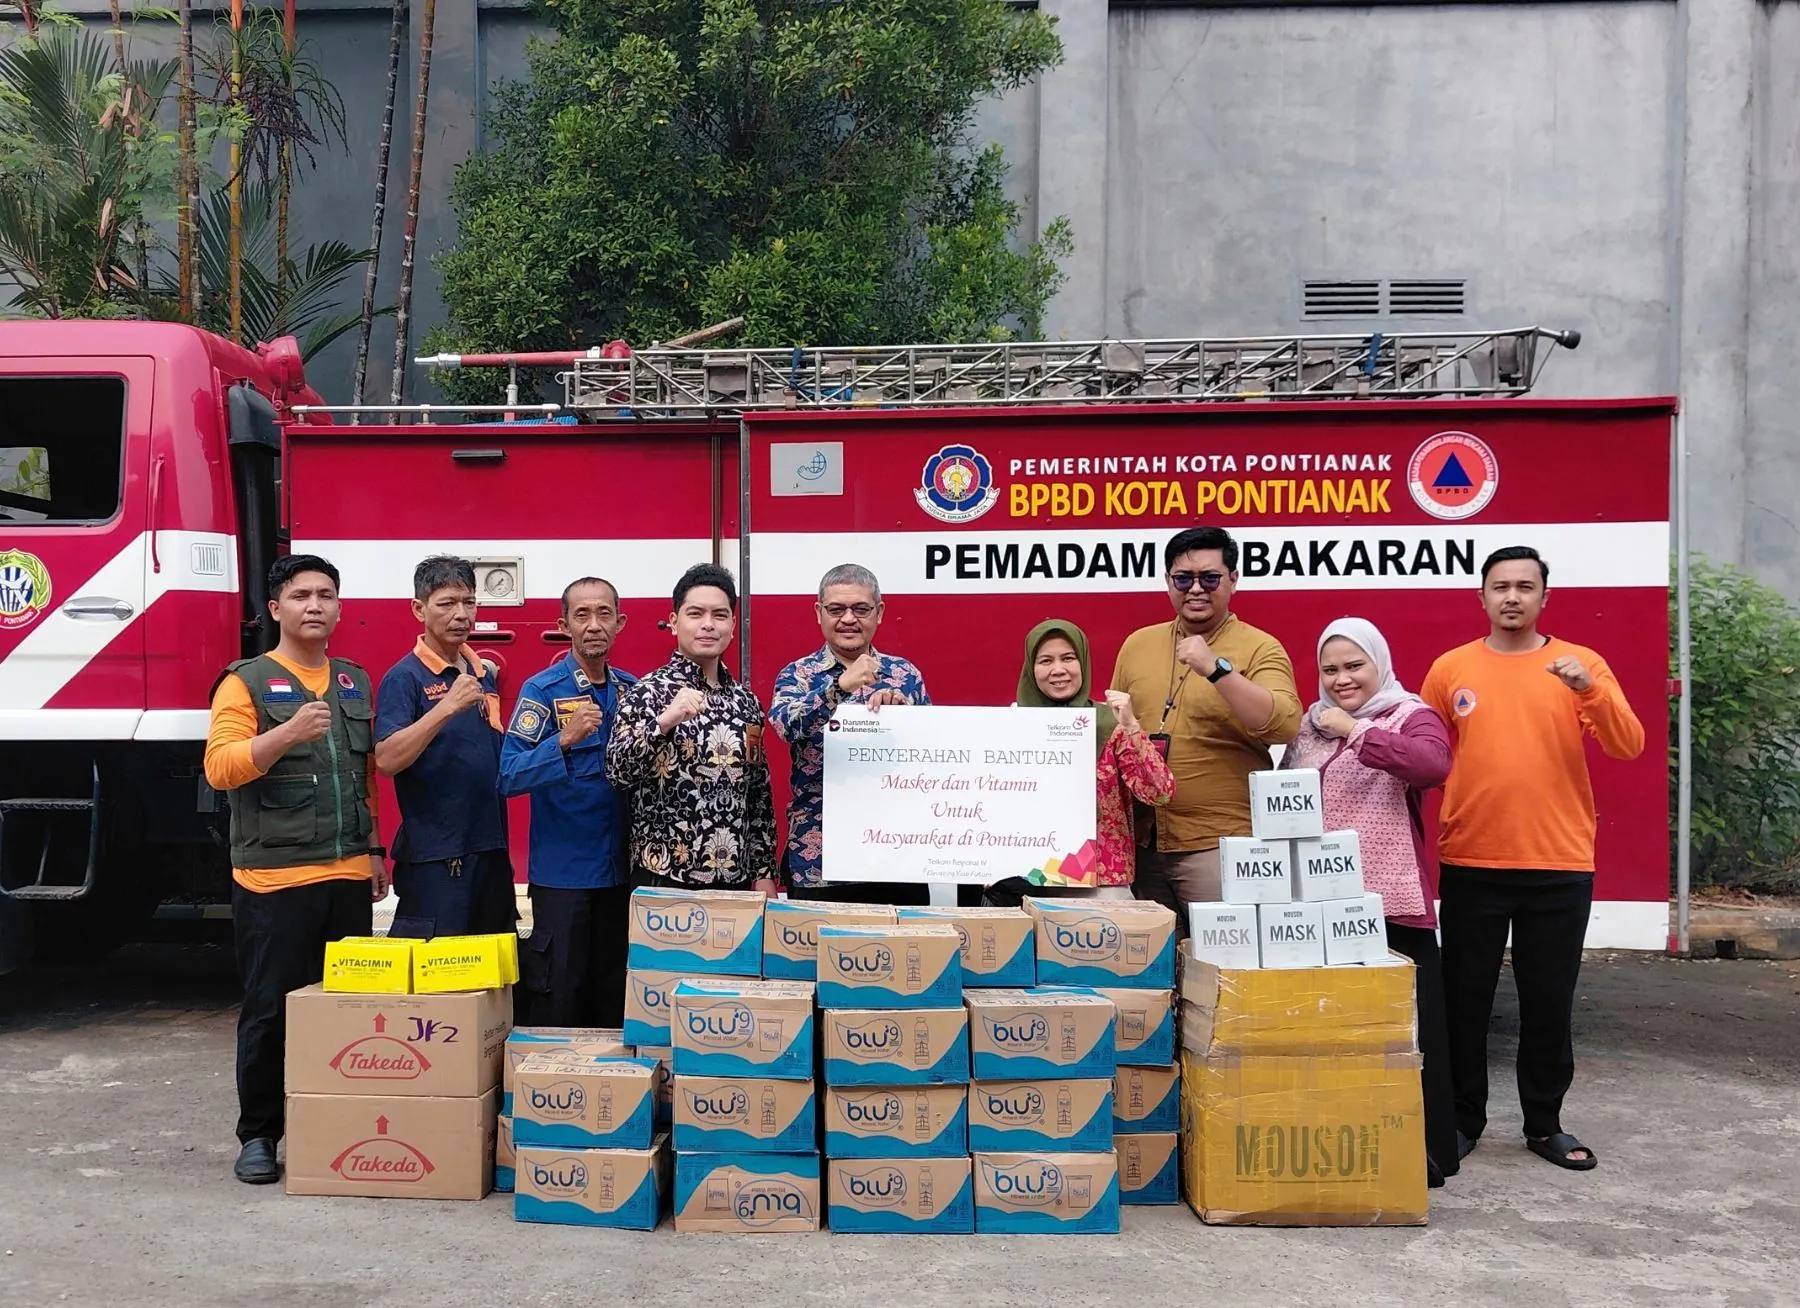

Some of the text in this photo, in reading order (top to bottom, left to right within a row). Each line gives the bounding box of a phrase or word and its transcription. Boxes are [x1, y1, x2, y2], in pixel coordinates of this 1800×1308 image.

[1010, 454, 1392, 475] PEMERINTAH KOTA PONTIANAK
[1009, 479, 1391, 517] BPBD KOTA PONTIANAK
[925, 539, 1475, 579] PEMADAM BAKARAN
[848, 747, 1072, 765] PENYERAHAN BANTUAN
[880, 772, 1038, 793] Masker dan Vitamin
[930, 801, 987, 822] Untuk
[1266, 794, 1315, 813] MASK
[861, 827, 1061, 852] Masyarakat di Pontianak
[1236, 860, 1284, 878] MASK
[1308, 855, 1356, 876] MASK
[1202, 928, 1251, 946] MASK
[1269, 924, 1317, 942] MASK
[1332, 917, 1380, 938] MASK
[338, 958, 393, 969] VITACIMIN
[427, 954, 482, 967] VITACIMIN
[349, 1052, 416, 1071] Takeda
[1235, 1123, 1380, 1178] MOUSON
[350, 1155, 419, 1174] Takeda
